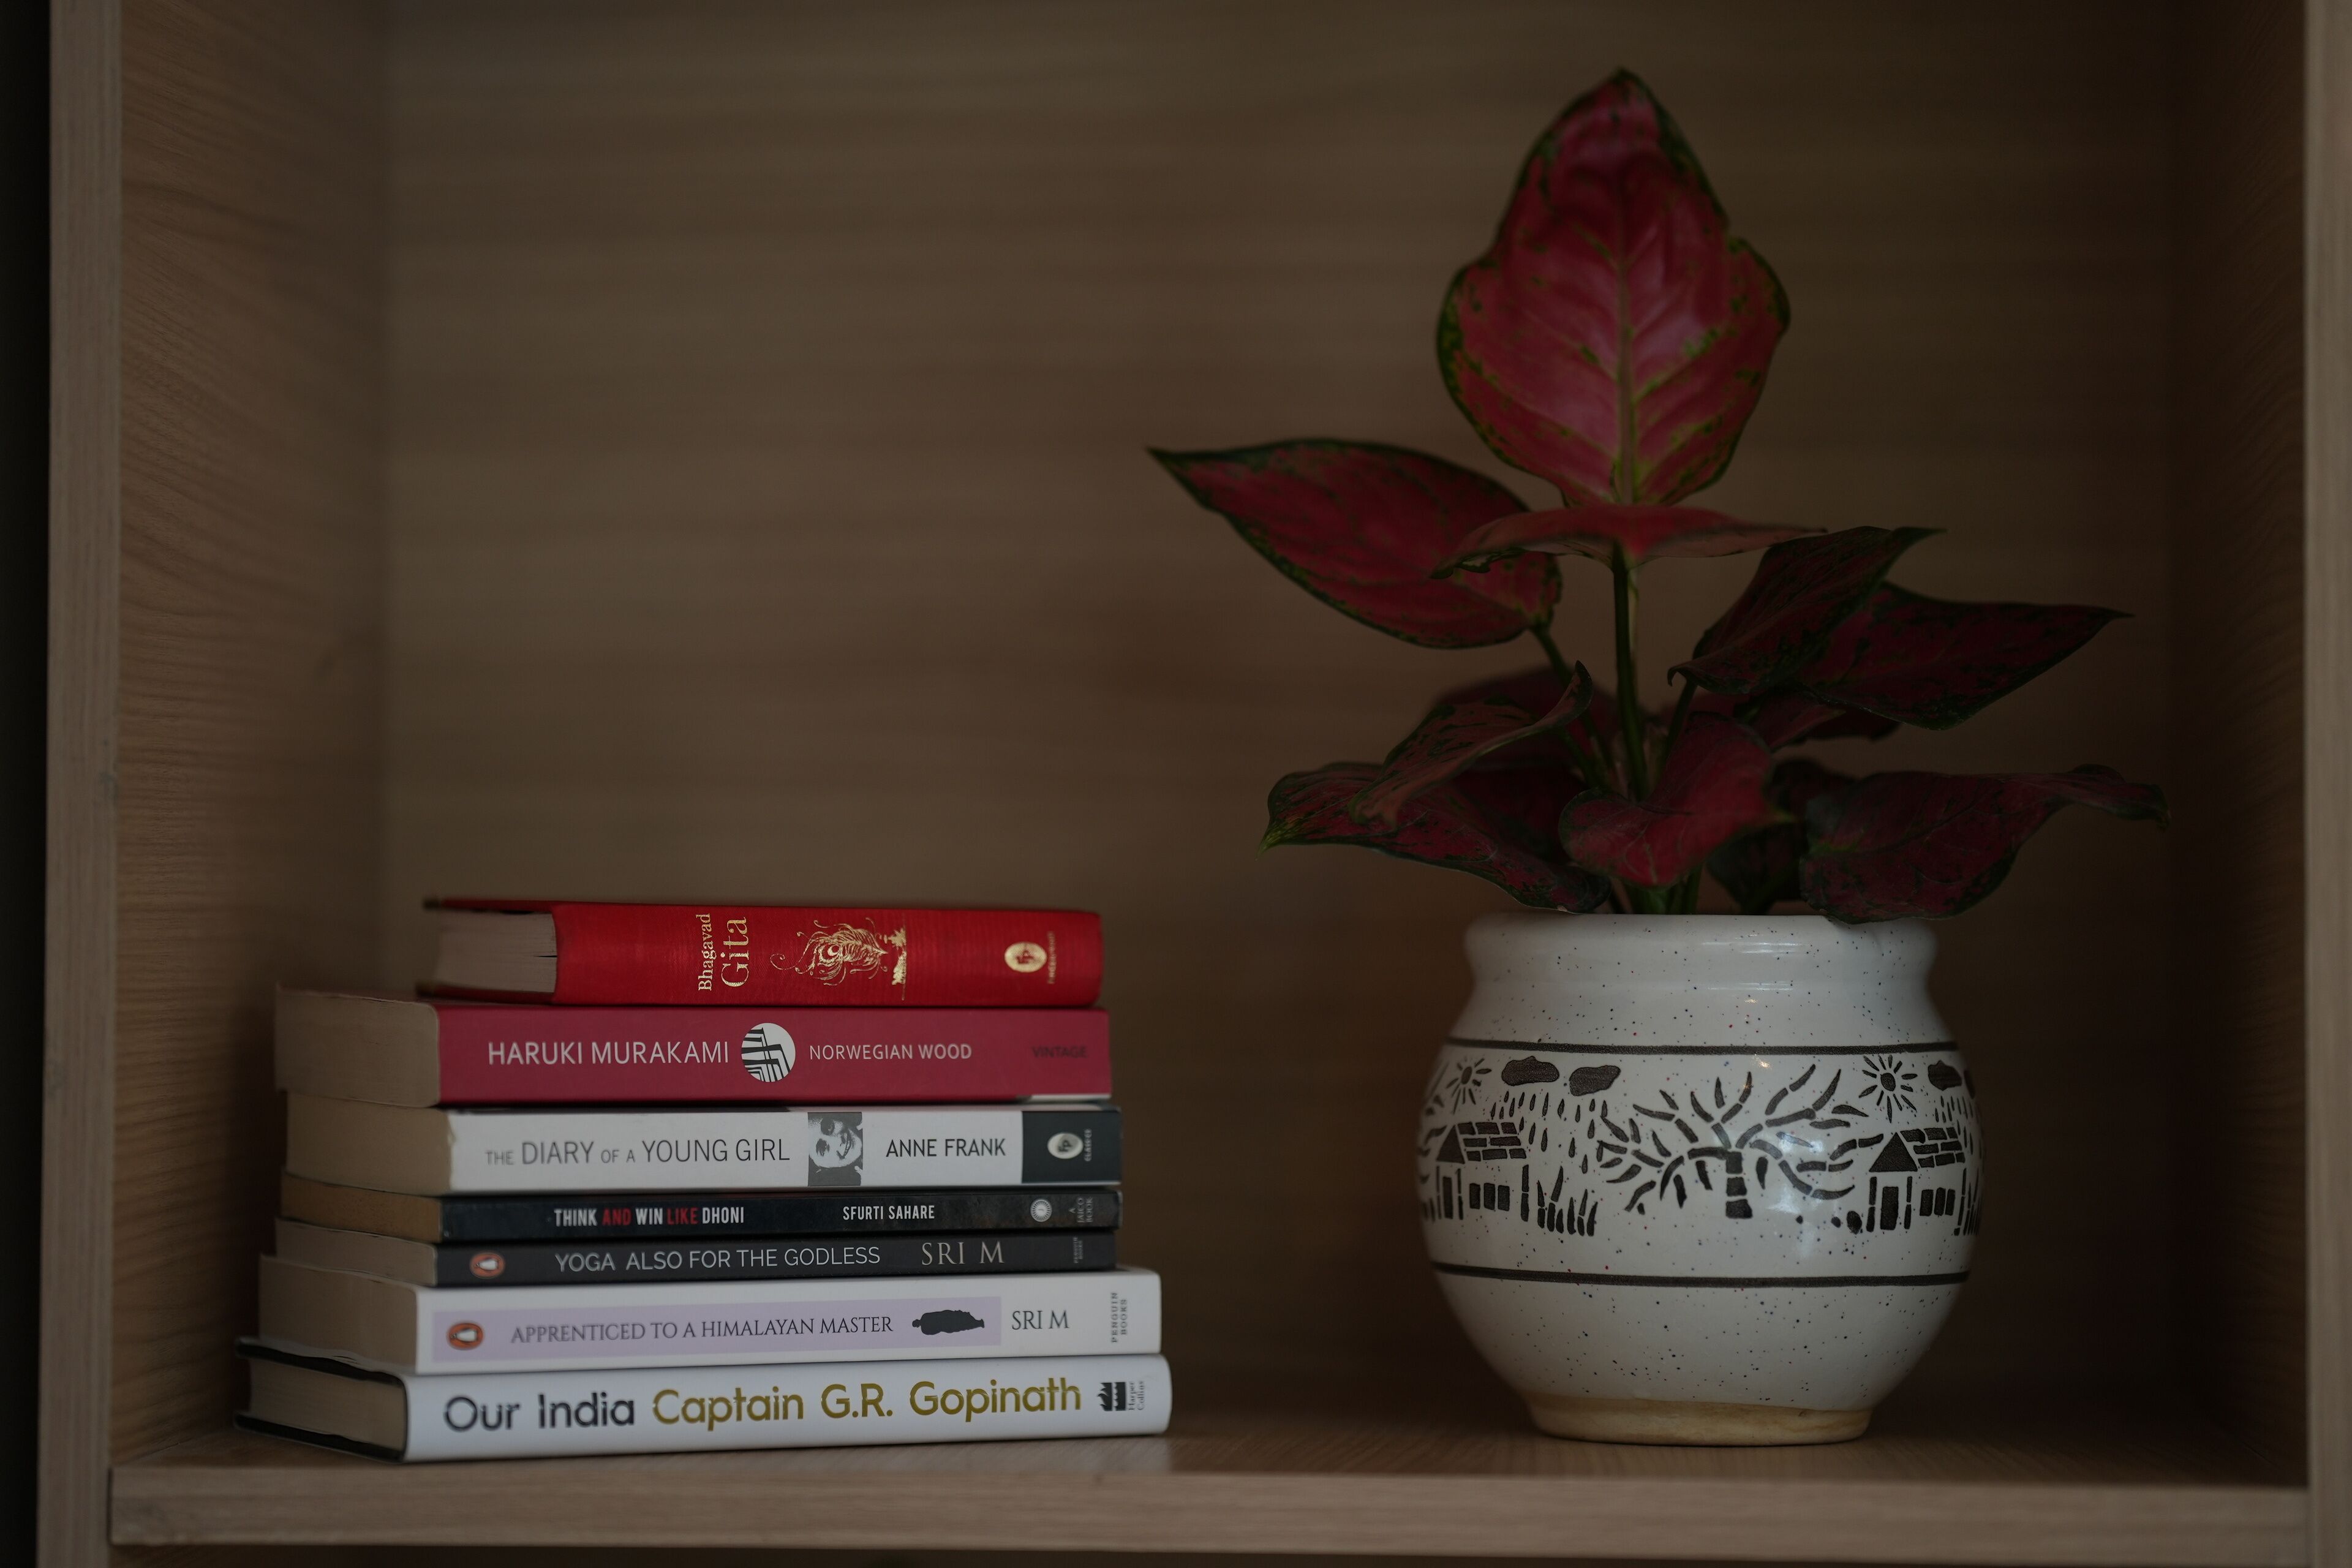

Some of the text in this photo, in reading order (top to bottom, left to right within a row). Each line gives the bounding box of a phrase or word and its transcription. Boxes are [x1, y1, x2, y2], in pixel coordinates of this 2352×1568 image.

[695, 913, 717, 991] Bhagavad
[720, 916, 749, 987] Gita
[488, 1041, 728, 1065] HARUKI MURAKAMI
[810, 1043, 972, 1060] NORWEGIAN WOOD
[1032, 1046, 1088, 1059] VINTAGE
[484, 1139, 790, 1166] THE DIARY OF A YOUNG GIRL
[886, 1138, 1006, 1158] ANNE FRANK
[554, 1207, 744, 1227] THINK AND WIN LIKE DHONI
[843, 1205, 935, 1221] SFURTI SAHARE
[555, 1246, 880, 1272] YOGA ALSO FOR THE GODLESS
[922, 1241, 1004, 1265] SRI M
[511, 1316, 894, 1343] APPRENTICED TO A HIMALAYAN MASTER
[1011, 1310, 1069, 1330] SRI M
[443, 1392, 635, 1433] Our India
[652, 1377, 1081, 1432] Captain G.R. Gopinath
